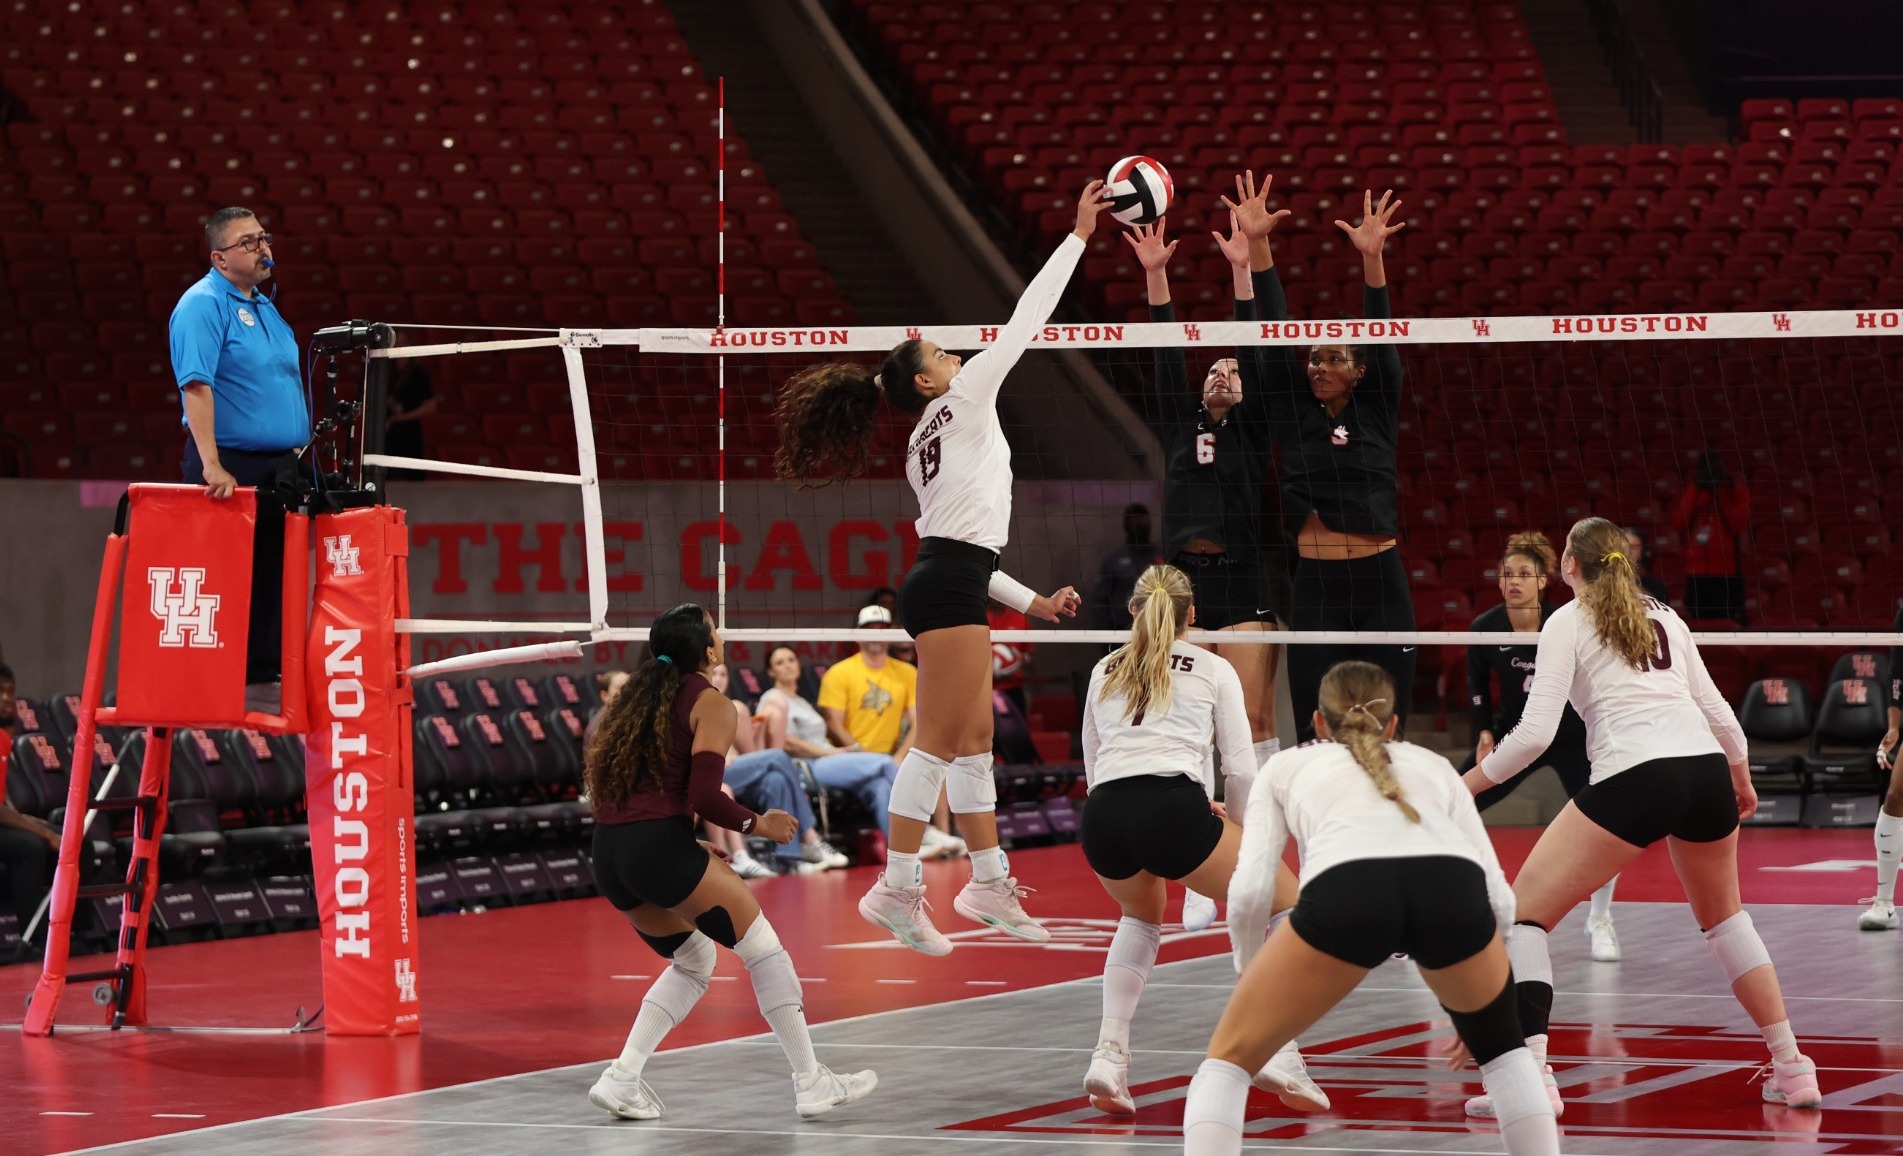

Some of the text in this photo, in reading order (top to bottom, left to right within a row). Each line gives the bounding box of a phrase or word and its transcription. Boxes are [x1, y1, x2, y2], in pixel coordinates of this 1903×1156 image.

[710, 330, 848, 347] HOUSTON
[980, 326, 1124, 342] HSTON
[1183, 324, 1200, 341] UH
[1260, 322, 1409, 338] HOUSTON
[1472, 319, 1490, 336] UH
[1552, 316, 1708, 333] HOUSTON
[1772, 313, 1791, 331] UH
[1856, 312, 1903, 328] HO
[1196, 432, 1216, 465] 6
[323, 535, 361, 577] UH
[411, 521, 643, 594] THE
[147, 567, 221, 648] UH
[594, 640, 629, 665] BY
[324, 626, 371, 959] HOUSTON
[397, 817, 408, 872] sports
[394, 957, 418, 1003] UH
